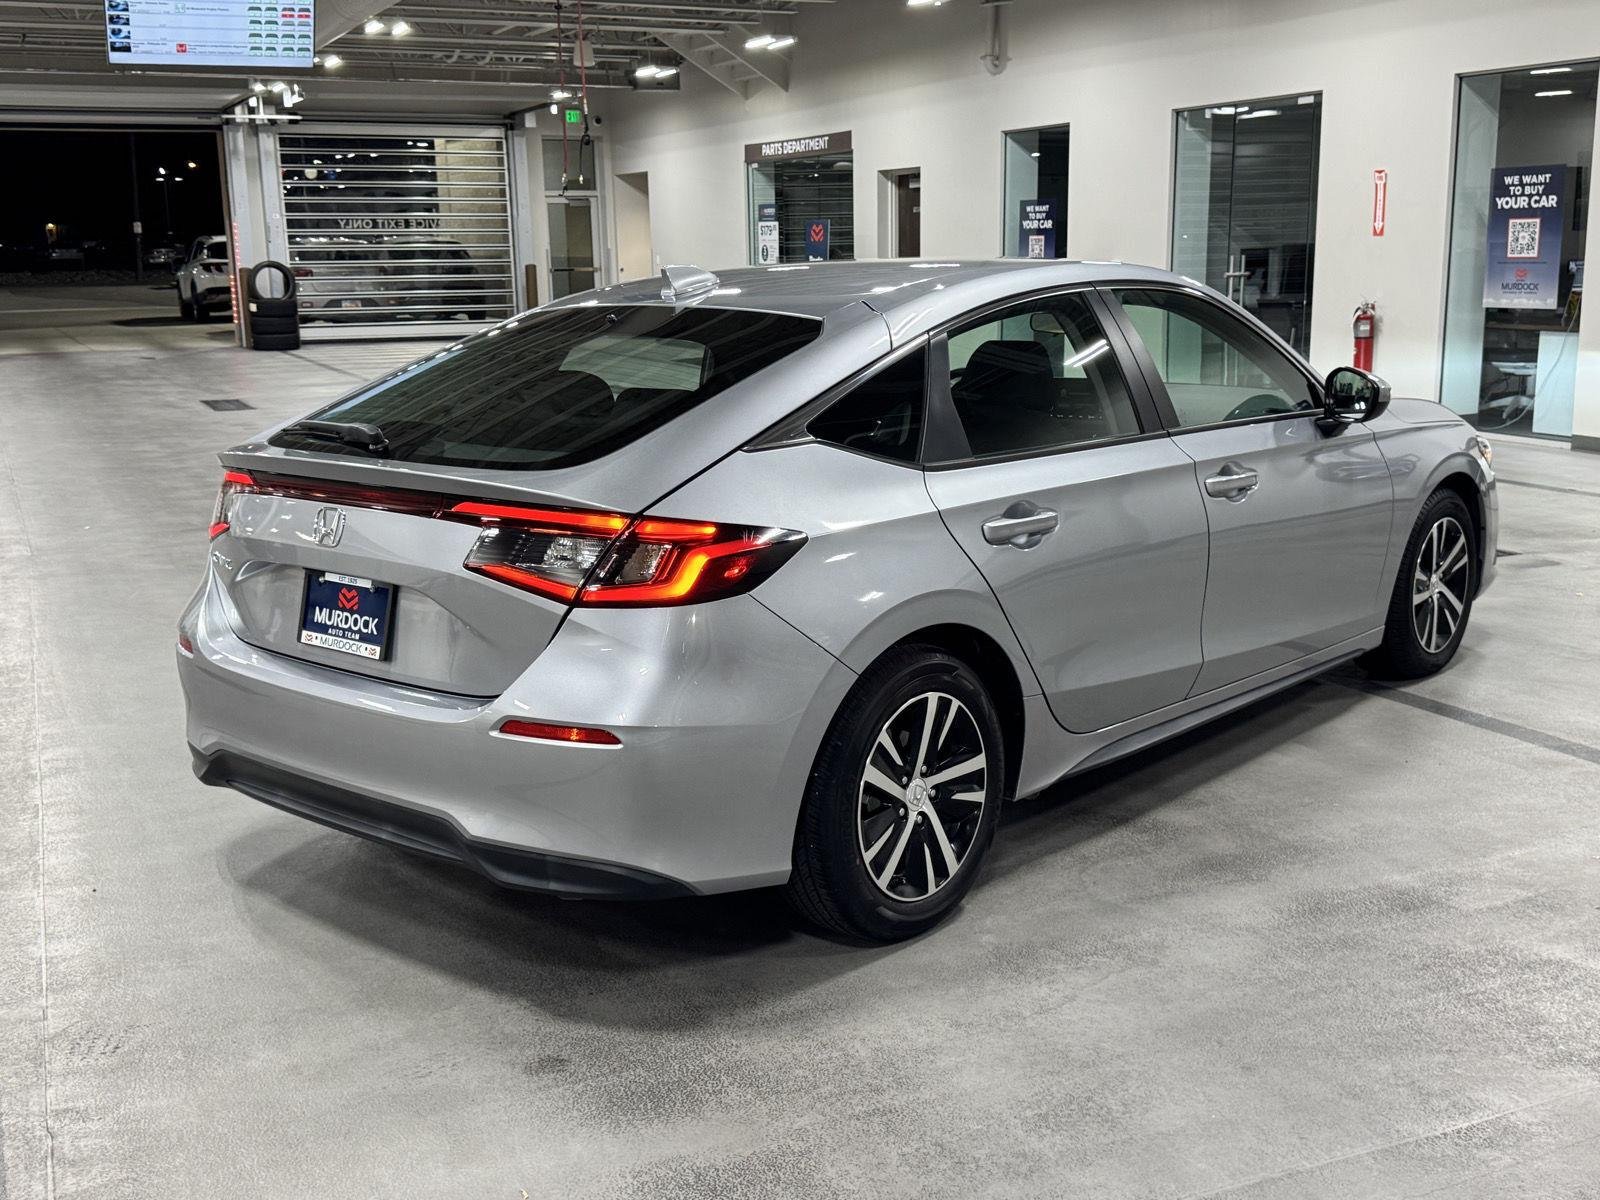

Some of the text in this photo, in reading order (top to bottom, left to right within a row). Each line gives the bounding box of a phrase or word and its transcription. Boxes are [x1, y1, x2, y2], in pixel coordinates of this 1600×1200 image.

[761, 137, 829, 156] PARTS DEPARTMENT
[1504, 174, 1551, 185] WE WANT
[1509, 185, 1544, 195] TO BUY
[1496, 195, 1557, 209] YOUR CAR
[1022, 220, 1053, 229] YOUR CAR
[1501, 282, 1539, 291] MURDOCK
[314, 606, 379, 635] MURDOCK
[328, 628, 360, 640] AUTO TEAM
[320, 636, 363, 654] MURDOCK
